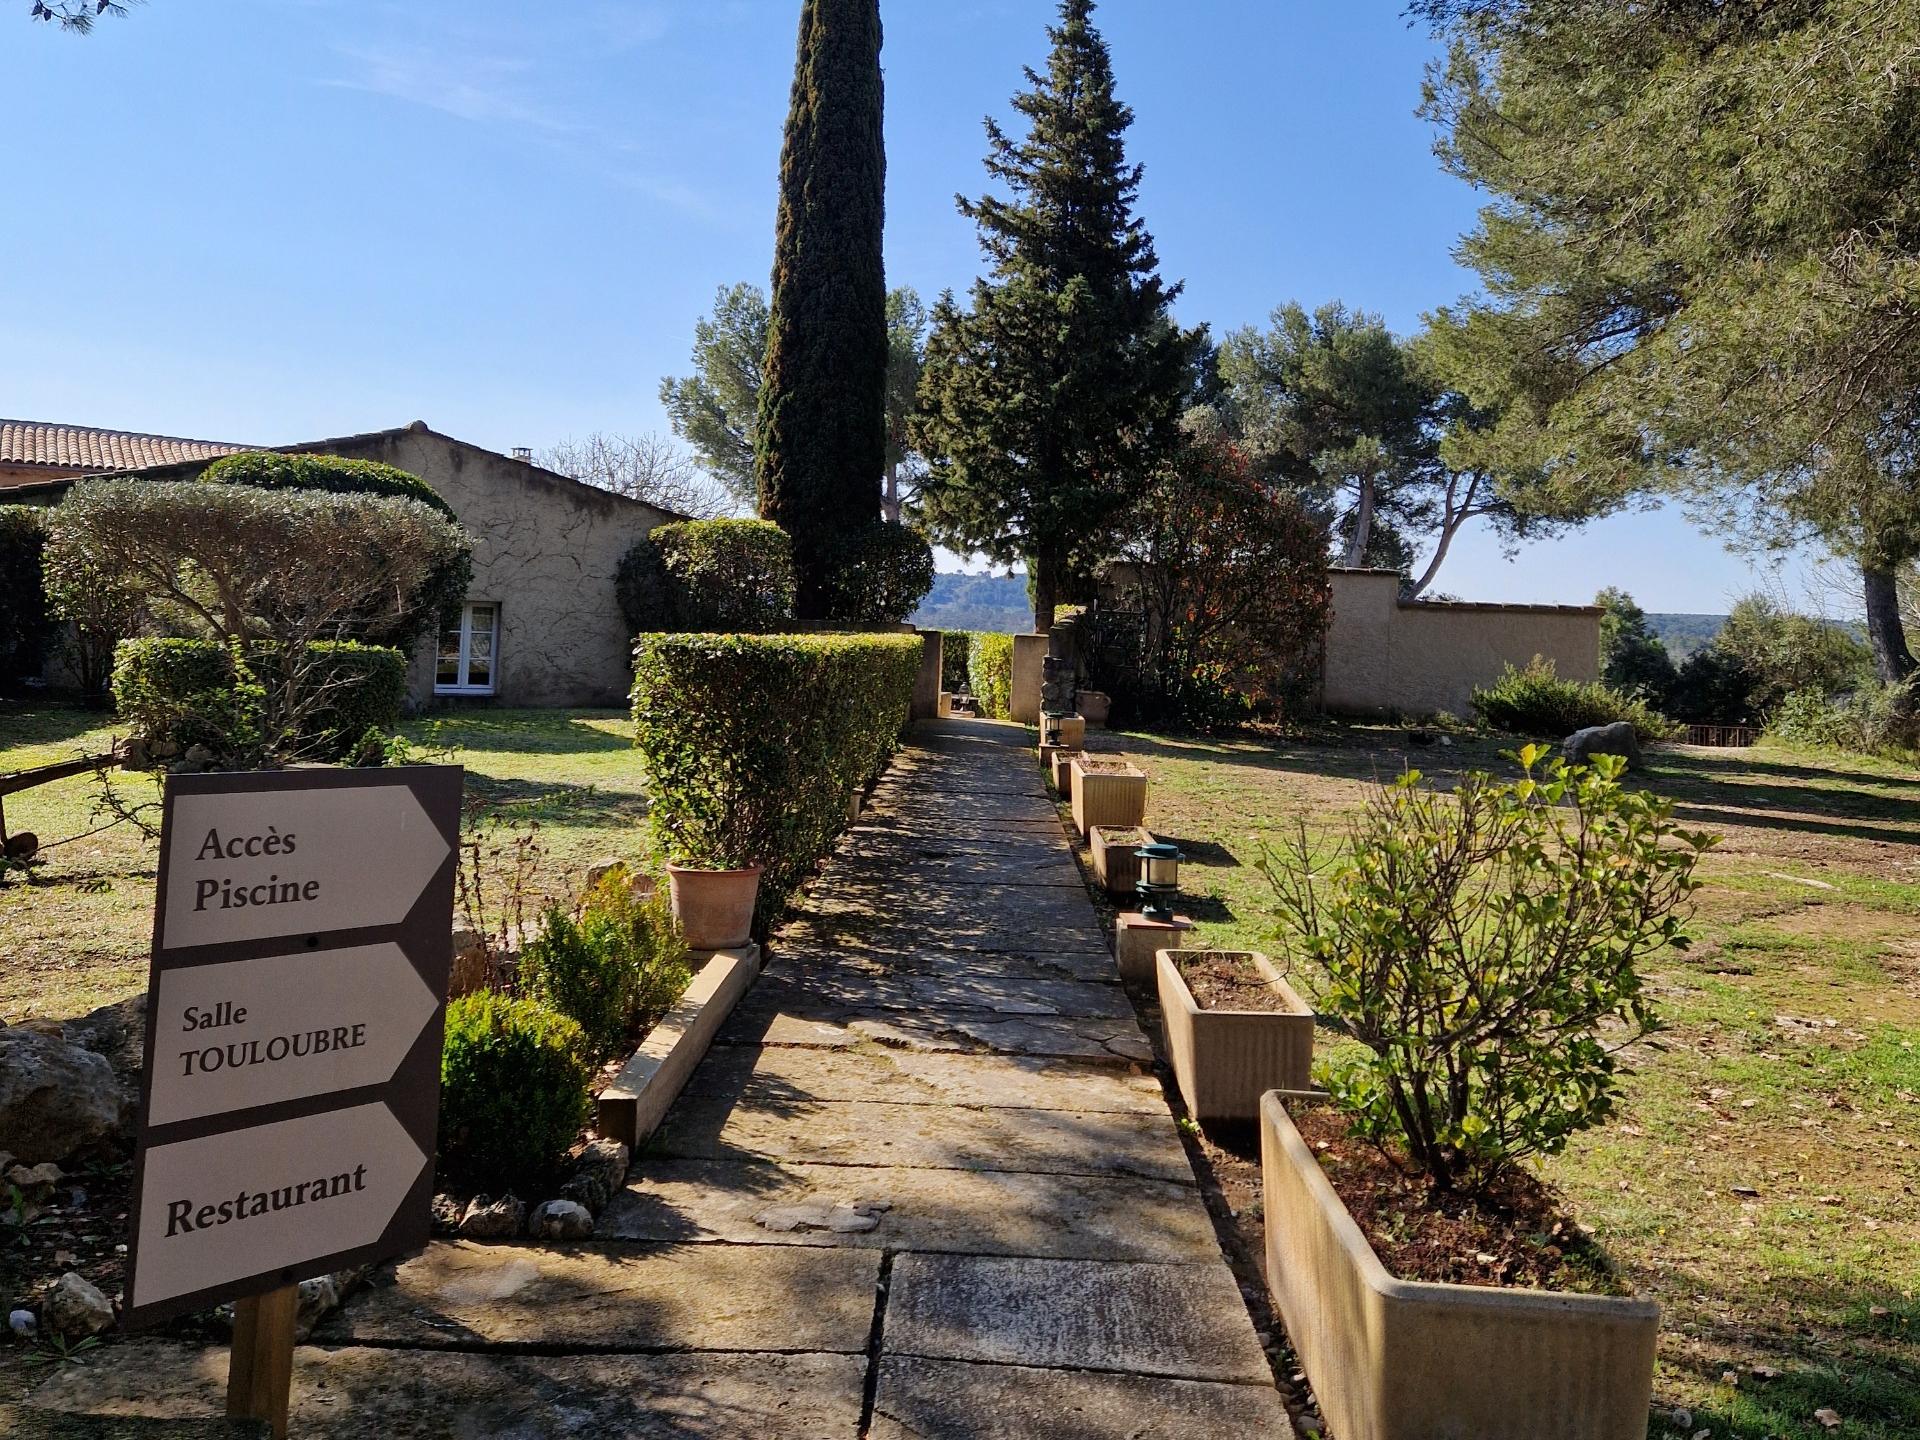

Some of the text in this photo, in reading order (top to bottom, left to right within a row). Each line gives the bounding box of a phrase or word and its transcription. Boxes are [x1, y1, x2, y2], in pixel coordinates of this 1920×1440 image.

[195, 826, 296, 861] Accès
[193, 874, 319, 911] Piscine
[182, 1001, 248, 1032] Salle
[179, 1023, 366, 1076] TOULOUBRE
[164, 1164, 367, 1238] Restaurant
